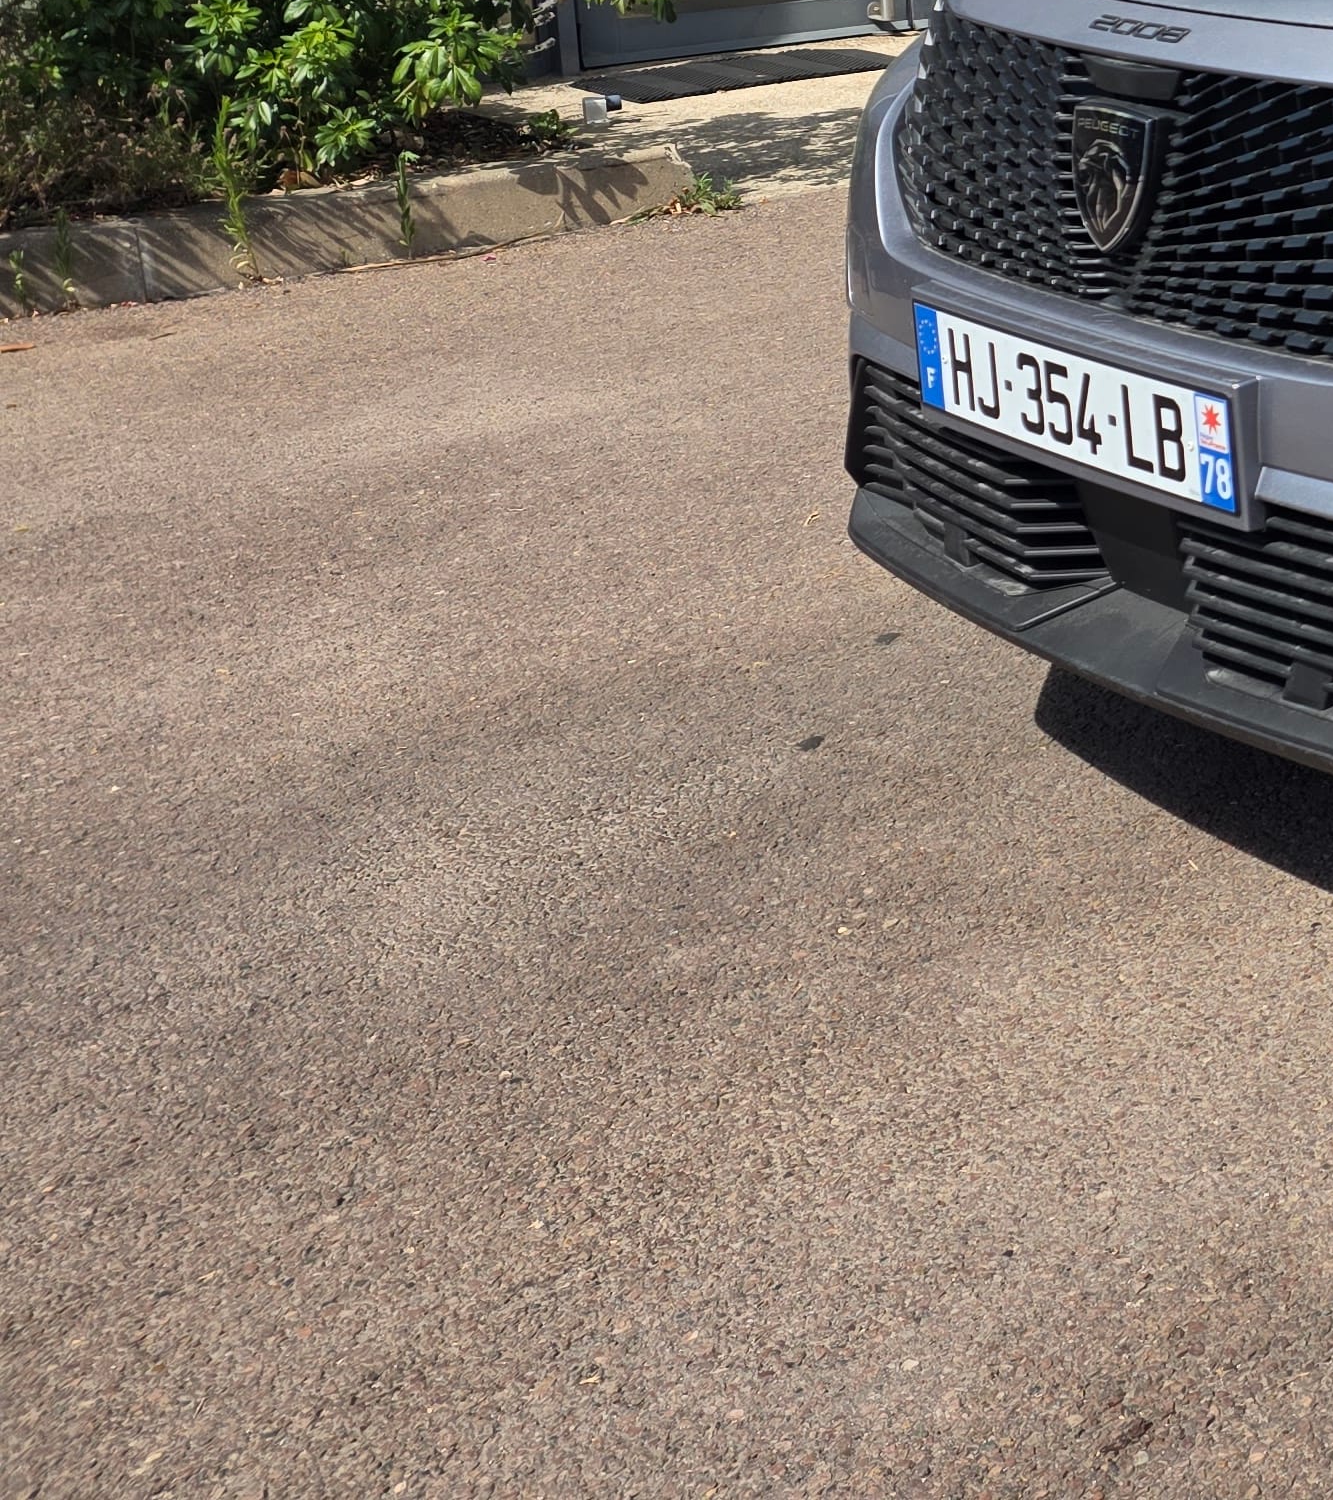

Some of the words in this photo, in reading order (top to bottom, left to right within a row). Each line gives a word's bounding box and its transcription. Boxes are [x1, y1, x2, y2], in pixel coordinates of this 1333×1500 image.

[1087, 13, 1193, 45] 2008
[1077, 116, 1140, 140] PEUGEOT
[926, 366, 937, 389] F
[947, 327, 1187, 483] HJ-354-LB
[1199, 452, 1233, 501] 78
